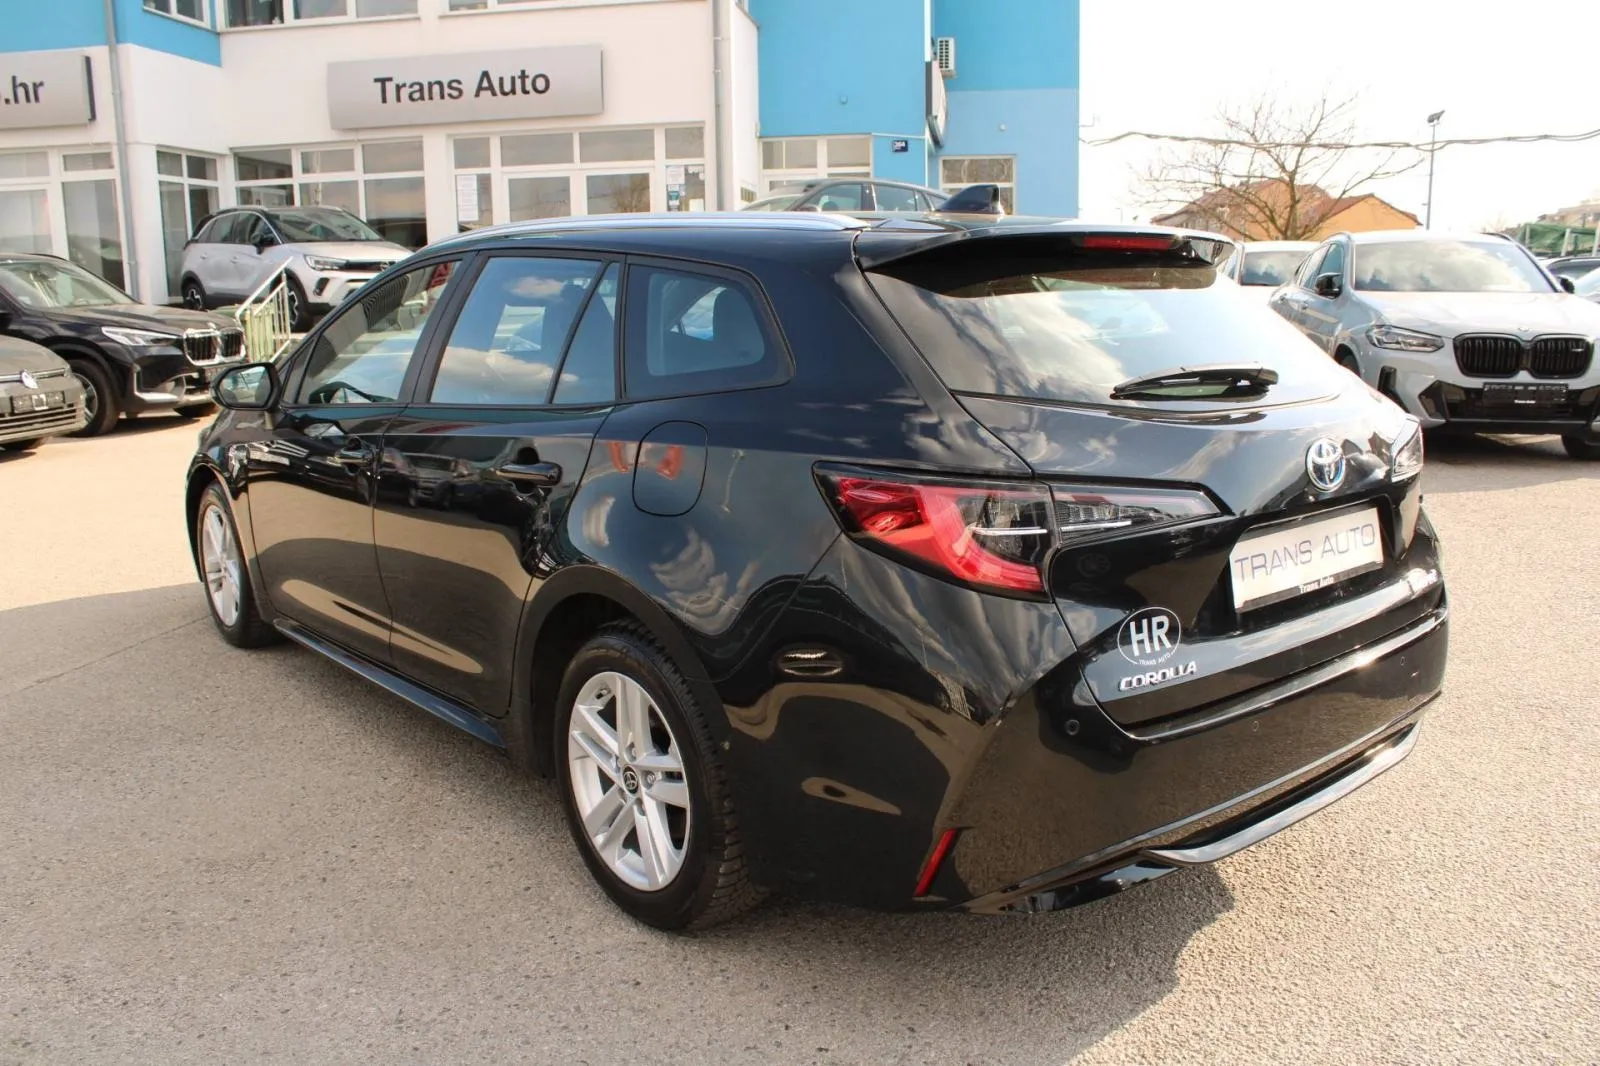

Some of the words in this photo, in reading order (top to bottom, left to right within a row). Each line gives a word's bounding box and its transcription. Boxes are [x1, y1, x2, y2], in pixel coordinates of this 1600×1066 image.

[0, 75, 45, 105] .hr
[373, 76, 464, 104] Trans
[474, 69, 551, 98] Auto
[1234, 539, 1313, 582] TRANS
[1320, 523, 1376, 560] AUTO
[1129, 615, 1172, 657] HR
[1118, 660, 1198, 691] COROLLA
[1138, 658, 1157, 666] TRANS
